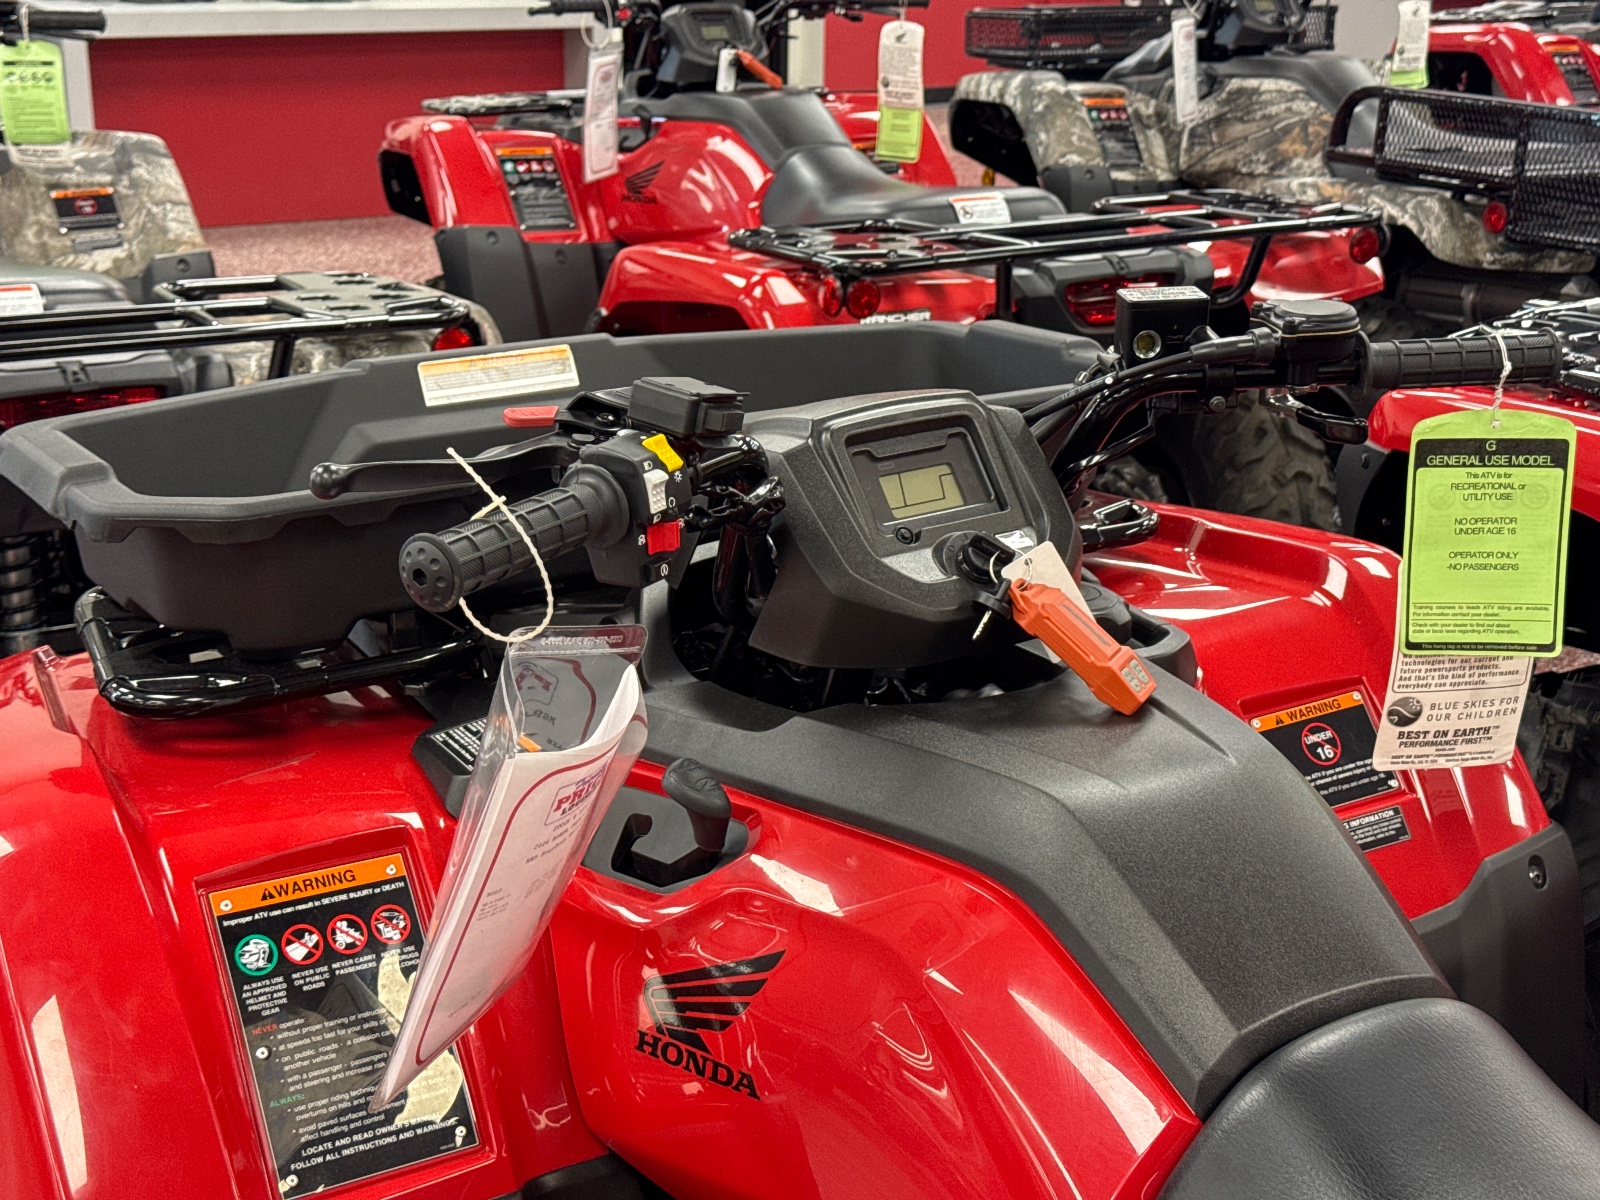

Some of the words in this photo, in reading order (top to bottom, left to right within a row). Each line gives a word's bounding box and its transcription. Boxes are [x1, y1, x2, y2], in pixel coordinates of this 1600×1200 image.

[1486, 440, 1496, 450] G
[1426, 455, 1483, 465] GENERAL
[1485, 455, 1509, 465] USE
[1511, 455, 1555, 465] MODEL
[1451, 482, 1516, 490] RECREATIONAL
[1454, 517, 1467, 525] NO
[1469, 517, 1517, 525] OPERATOR
[1463, 563, 1519, 571] PASSENGERS
[1400, 658, 1445, 667] technologies
[1477, 669, 1519, 678] performance
[1396, 682, 1432, 690] everybody
[1448, 678, 1488, 687] appreciate.
[1286, 699, 1341, 721] WARNING
[1429, 701, 1459, 710] BLUE
[1462, 698, 1495, 708] SKIES
[1499, 696, 1519, 705] FOR
[1426, 712, 1451, 721] OUR
[1457, 707, 1516, 719] CHILDREN
[1303, 730, 1332, 744] UNDER
[1396, 729, 1430, 740] BEST
[1432, 728, 1449, 738] ON
[1398, 737, 1459, 748] PERFORMANCE
[1315, 744, 1335, 760] 16
[273, 869, 356, 897] WARNING
[222, 914, 253, 927] Improper
[254, 911, 268, 919] ATV
[294, 901, 313, 910] result
[321, 893, 348, 904] SEVERE
[349, 888, 373, 898] INJURY
[381, 881, 404, 891] DEATH
[380, 948, 401, 957] NEVER
[331, 959, 352, 968] NEVER
[353, 953, 376, 963] CARRY
[335, 960, 377, 975] PASSENGERS
[291, 969, 314, 979] NEVER
[315, 965, 328, 973] USE
[293, 978, 304, 986] ON
[304, 972, 330, 983] PUBLIC
[242, 979, 270, 990] ALWAYS
[270, 975, 284, 984] USE
[252, 982, 287, 996] APPROVED
[302, 981, 325, 991] ROADS
[245, 994, 271, 1005] HELMET
[272, 990, 287, 998] AND
[247, 997, 288, 1012] PROTECTIVE
[260, 1006, 280, 1016] GEAR
[251, 1024, 277, 1035] NEVER
[278, 1017, 307, 1030] operate:
[276, 1028, 300, 1039] without
[301, 1023, 323, 1034] proper
[323, 1016, 348, 1028] training
[286, 1037, 310, 1049] speeds
[311, 1034, 321, 1042] too
[322, 1031, 335, 1039] fast
[347, 1025, 362, 1034] your
[361, 1020, 378, 1029] skills
[294, 1048, 316, 1060] public
[318, 1043, 338, 1052] roads
[352, 1032, 380, 1044] collision
[282, 1058, 310, 1071] another
[311, 1052, 336, 1063] vehicle
[286, 1074, 301, 1083] with
[308, 1064, 343, 1078] passenger
[350, 1053, 388, 1067] passengers
[635, 1029, 761, 1101] HONDA
[288, 1083, 302, 1091] and
[303, 1075, 331, 1089] steering
[331, 1071, 344, 1080] and
[344, 1064, 373, 1076] increase
[268, 1092, 305, 1107] ALWAYS:
[293, 1104, 306, 1112] use
[307, 1098, 329, 1109] proper
[330, 1092, 349, 1103] riding
[295, 1107, 327, 1120] overturns
[337, 1100, 351, 1109] hills
[352, 1097, 365, 1105] and
[297, 1123, 316, 1133] avoid
[317, 1117, 338, 1129] paved
[338, 1109, 366, 1122] surfaces
[299, 1132, 319, 1142] affect
[320, 1124, 348, 1138] handling
[348, 1120, 362, 1128] and
[362, 1114, 385, 1125] control
[290, 1156, 323, 1171] FOLLOW
[324, 1151, 340, 1161] ALL
[341, 1135, 397, 1156] INSTRUCTIONS
[398, 1130, 415, 1140] AND
[301, 1141, 333, 1156] LOCATE
[334, 1136, 351, 1147] AND
[352, 1130, 374, 1142] READ
